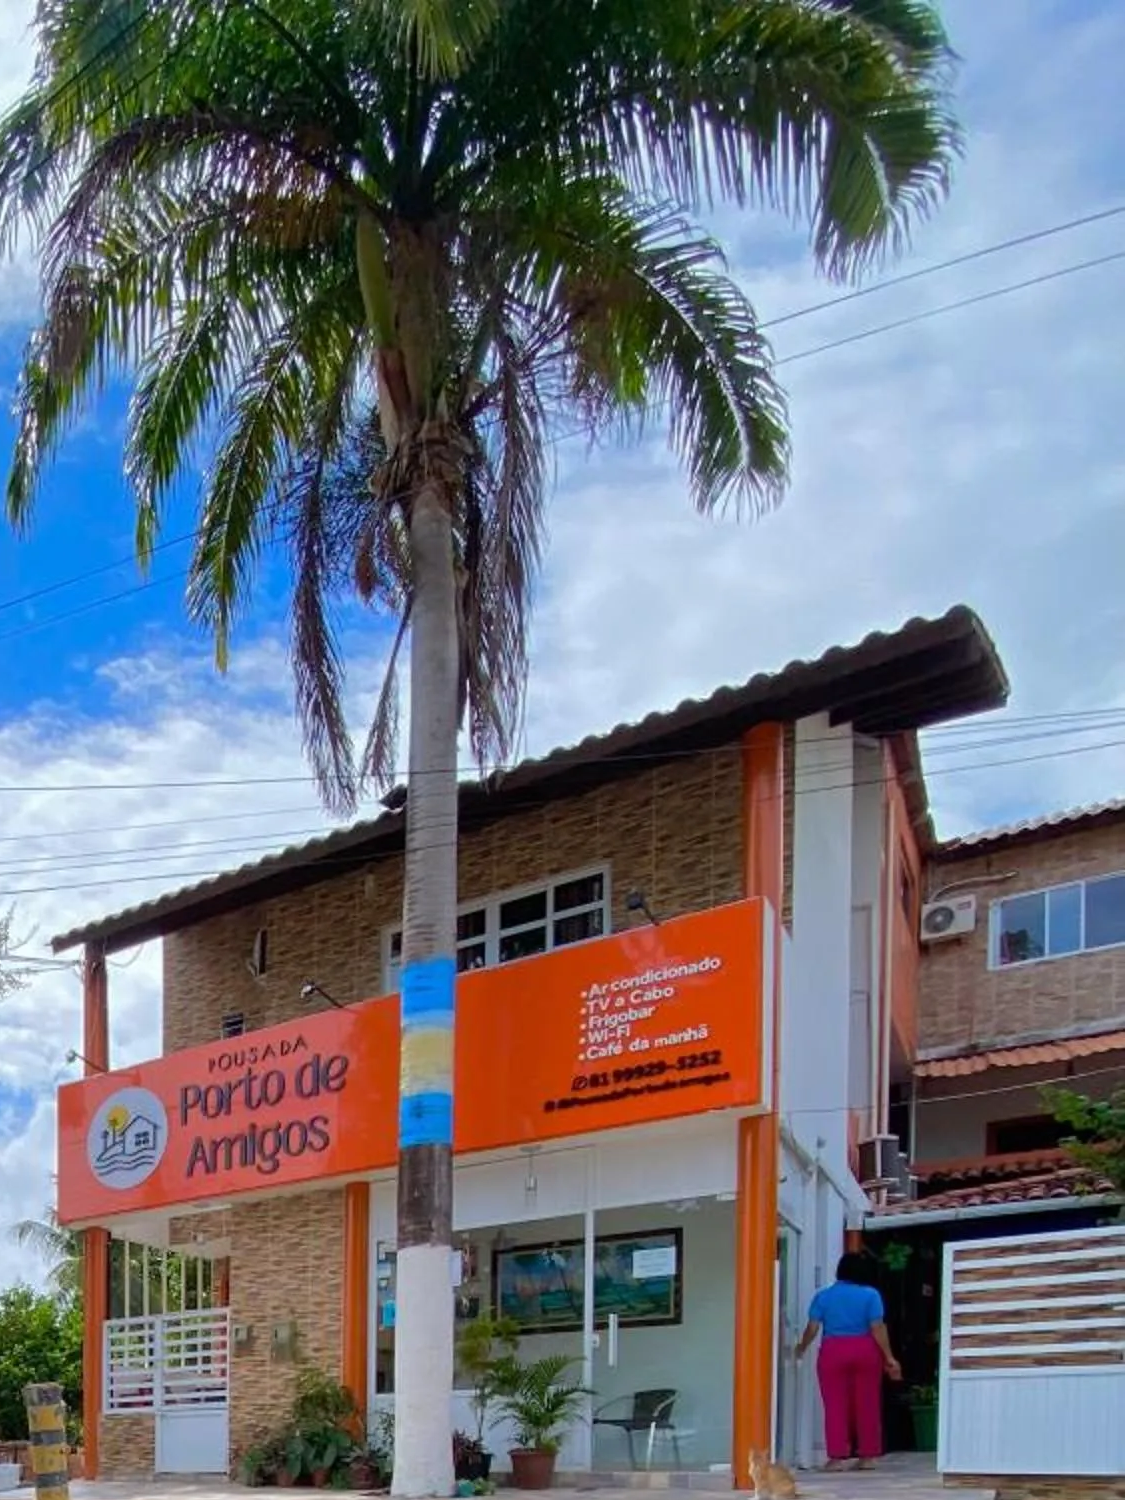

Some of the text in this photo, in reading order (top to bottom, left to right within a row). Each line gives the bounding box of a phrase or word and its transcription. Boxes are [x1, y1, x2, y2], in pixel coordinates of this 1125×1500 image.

[588, 957, 721, 999] Ar condicionado
[587, 998, 610, 1014] TV
[630, 986, 674, 1004] Cabo
[588, 1005, 656, 1028] Frigobar
[208, 1034, 308, 1073] POUSADA
[586, 1024, 708, 1059] Café da manhã
[180, 1053, 348, 1126] Porto de
[186, 1116, 330, 1178] Amigos
